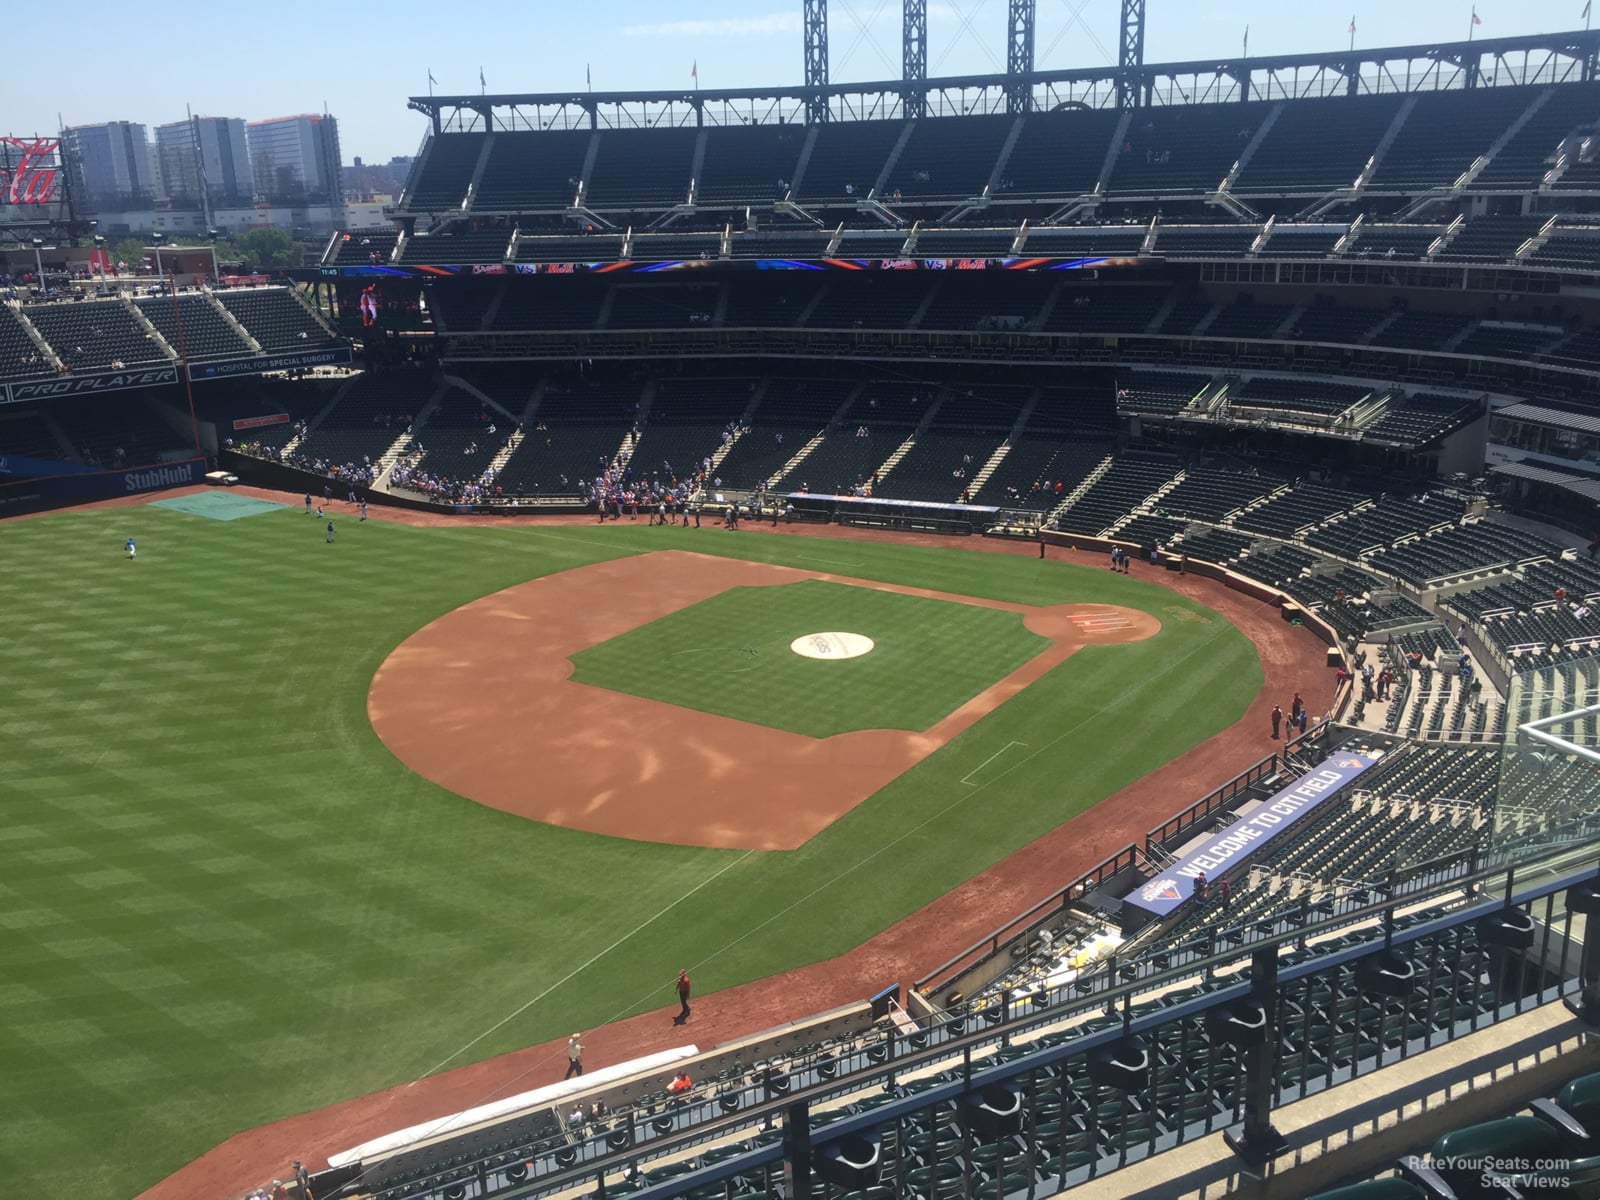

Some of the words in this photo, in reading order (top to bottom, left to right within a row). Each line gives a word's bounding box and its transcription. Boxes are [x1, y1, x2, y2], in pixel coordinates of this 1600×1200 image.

[321, 268, 338, 276] 11:45
[217, 363, 251, 373] HOSPITAL
[253, 361, 269, 369] FOR
[269, 358, 301, 368] SPECIAL
[302, 353, 336, 364] SURGERY
[15, 382, 72, 397] PRO
[75, 370, 174, 391] PLAYER
[124, 464, 192, 491] StubHub!
[1176, 825, 1263, 879] WELCOME
[1249, 812, 1281, 829] TO
[1269, 794, 1310, 816] CITI
[1295, 769, 1343, 798] FIELD
